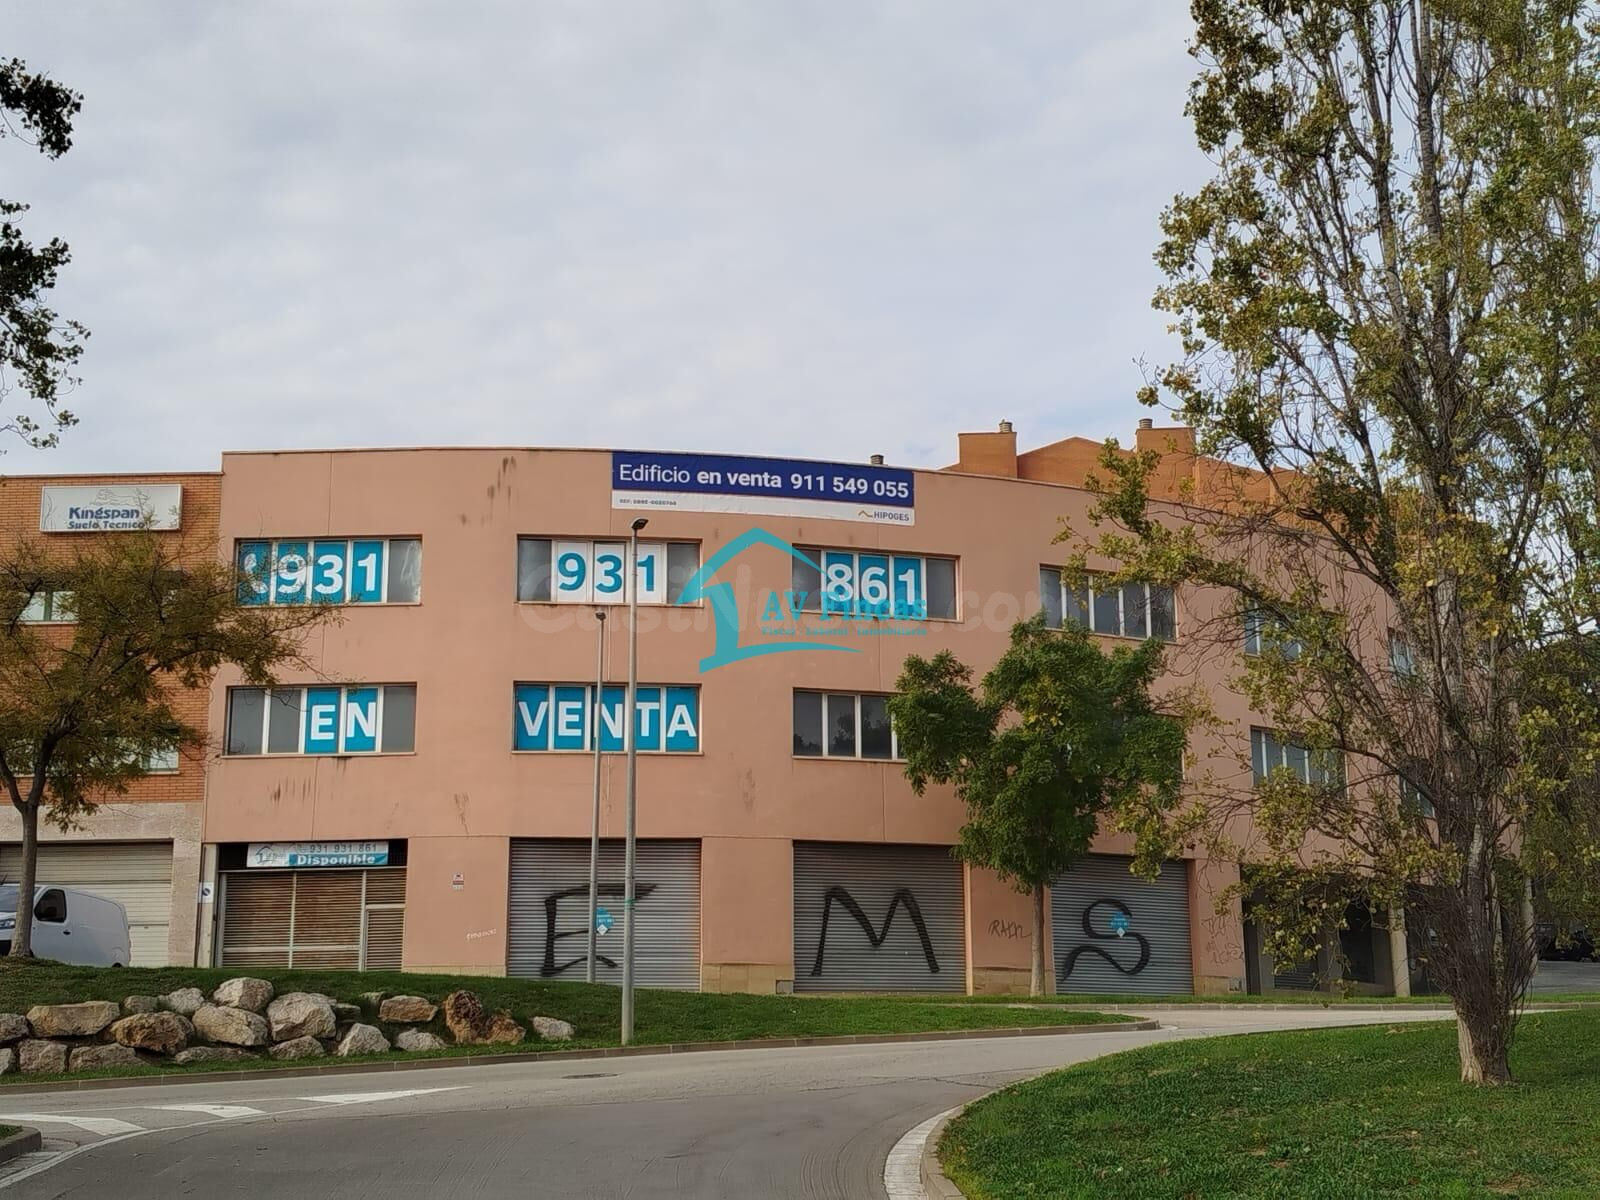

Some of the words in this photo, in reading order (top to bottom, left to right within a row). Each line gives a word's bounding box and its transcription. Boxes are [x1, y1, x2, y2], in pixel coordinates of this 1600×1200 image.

[619, 463, 690, 484] Edificio
[696, 470, 722, 485] en
[726, 470, 783, 488] venta
[790, 473, 825, 491] 911
[832, 476, 868, 495] 549
[873, 480, 909, 498] 055
[68, 506, 140, 520] Kingspan
[873, 511, 910, 522] HIPOGES
[67, 520, 100, 530] Suelo
[277, 553, 377, 595] 931
[557, 552, 656, 594] 931
[826, 563, 915, 606] 861
[310, 701, 377, 741] EN
[517, 700, 698, 739] VENTA
[309, 843, 328, 854] 931
[334, 843, 353, 853] 931
[358, 842, 377, 853] 861
[297, 852, 376, 866] Disponible
